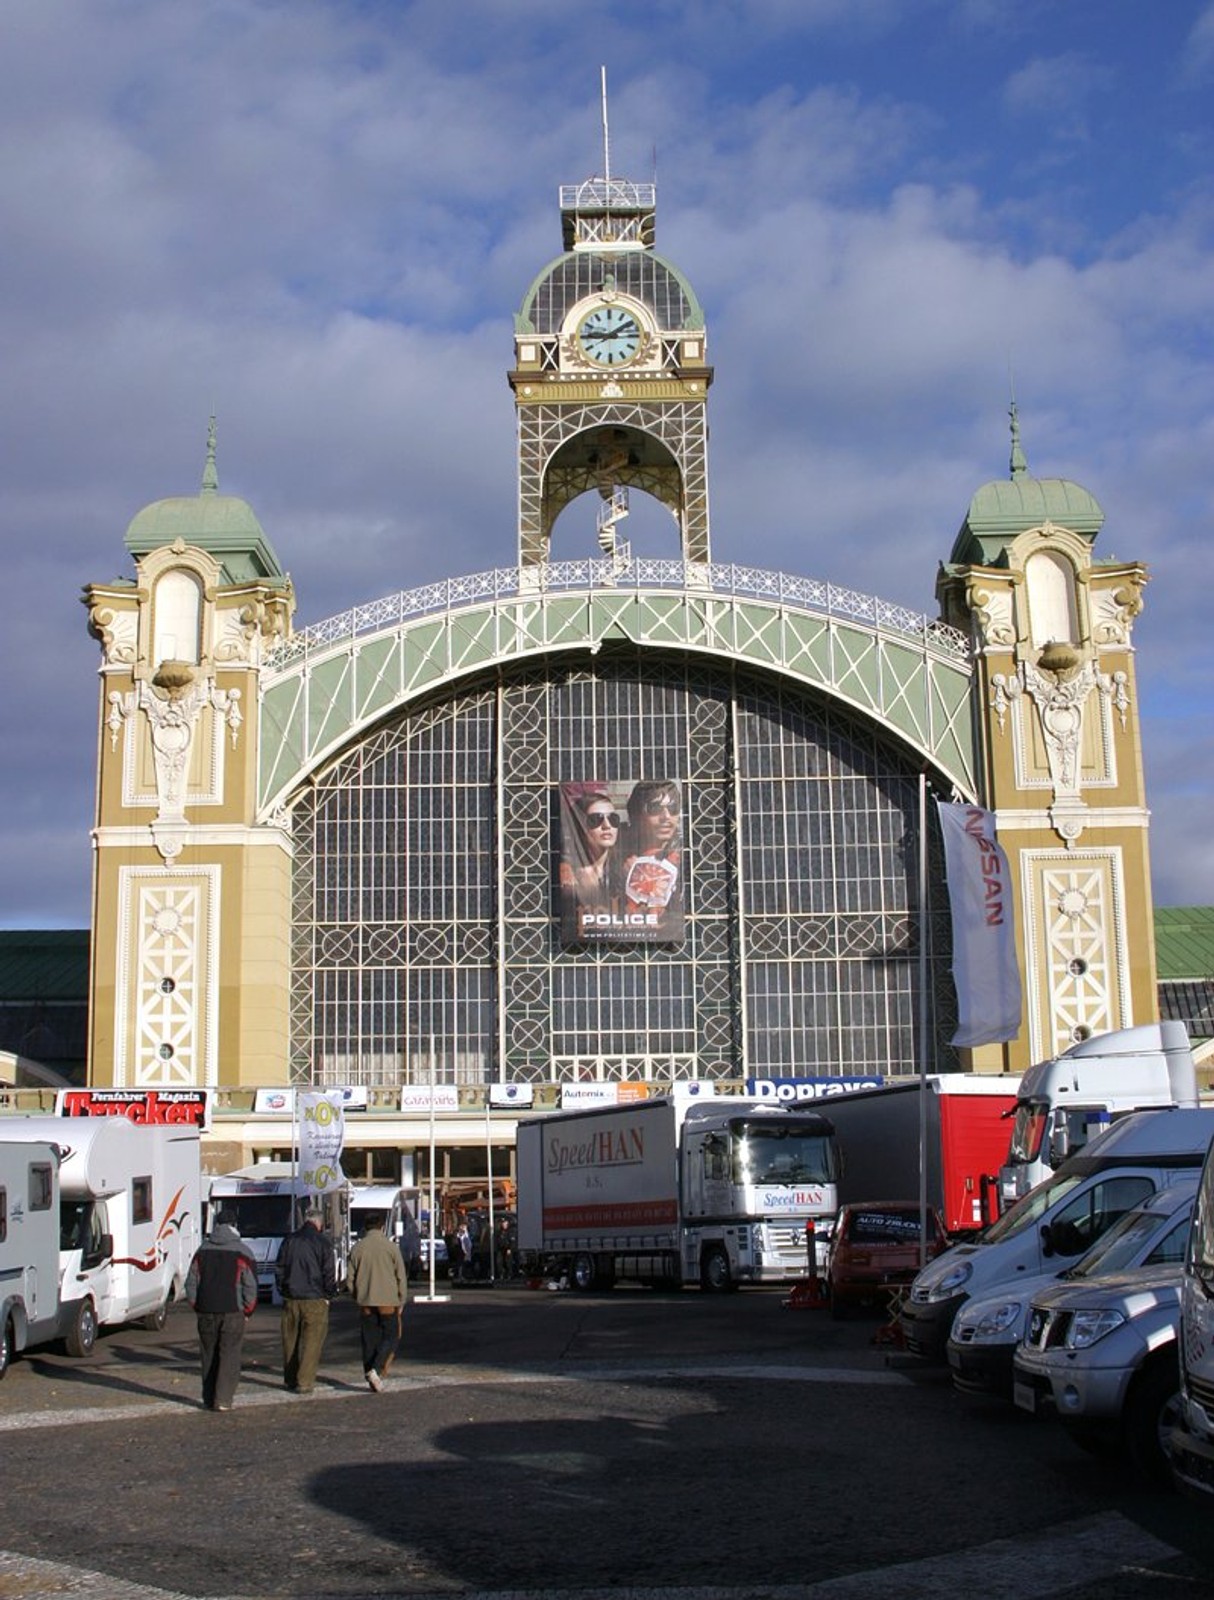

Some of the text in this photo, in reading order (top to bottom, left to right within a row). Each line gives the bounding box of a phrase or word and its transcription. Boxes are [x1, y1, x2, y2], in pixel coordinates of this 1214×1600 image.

[964, 809, 1004, 927] NISSAN
[582, 914, 658, 925] POLICE
[158, 1092, 200, 1103] Magazin
[64, 1092, 204, 1124] Trucker
[548, 1126, 645, 1176] SpeedHAN
[763, 1192, 823, 1207] SpeedHAN
[857, 1217, 884, 1225] AUTO
